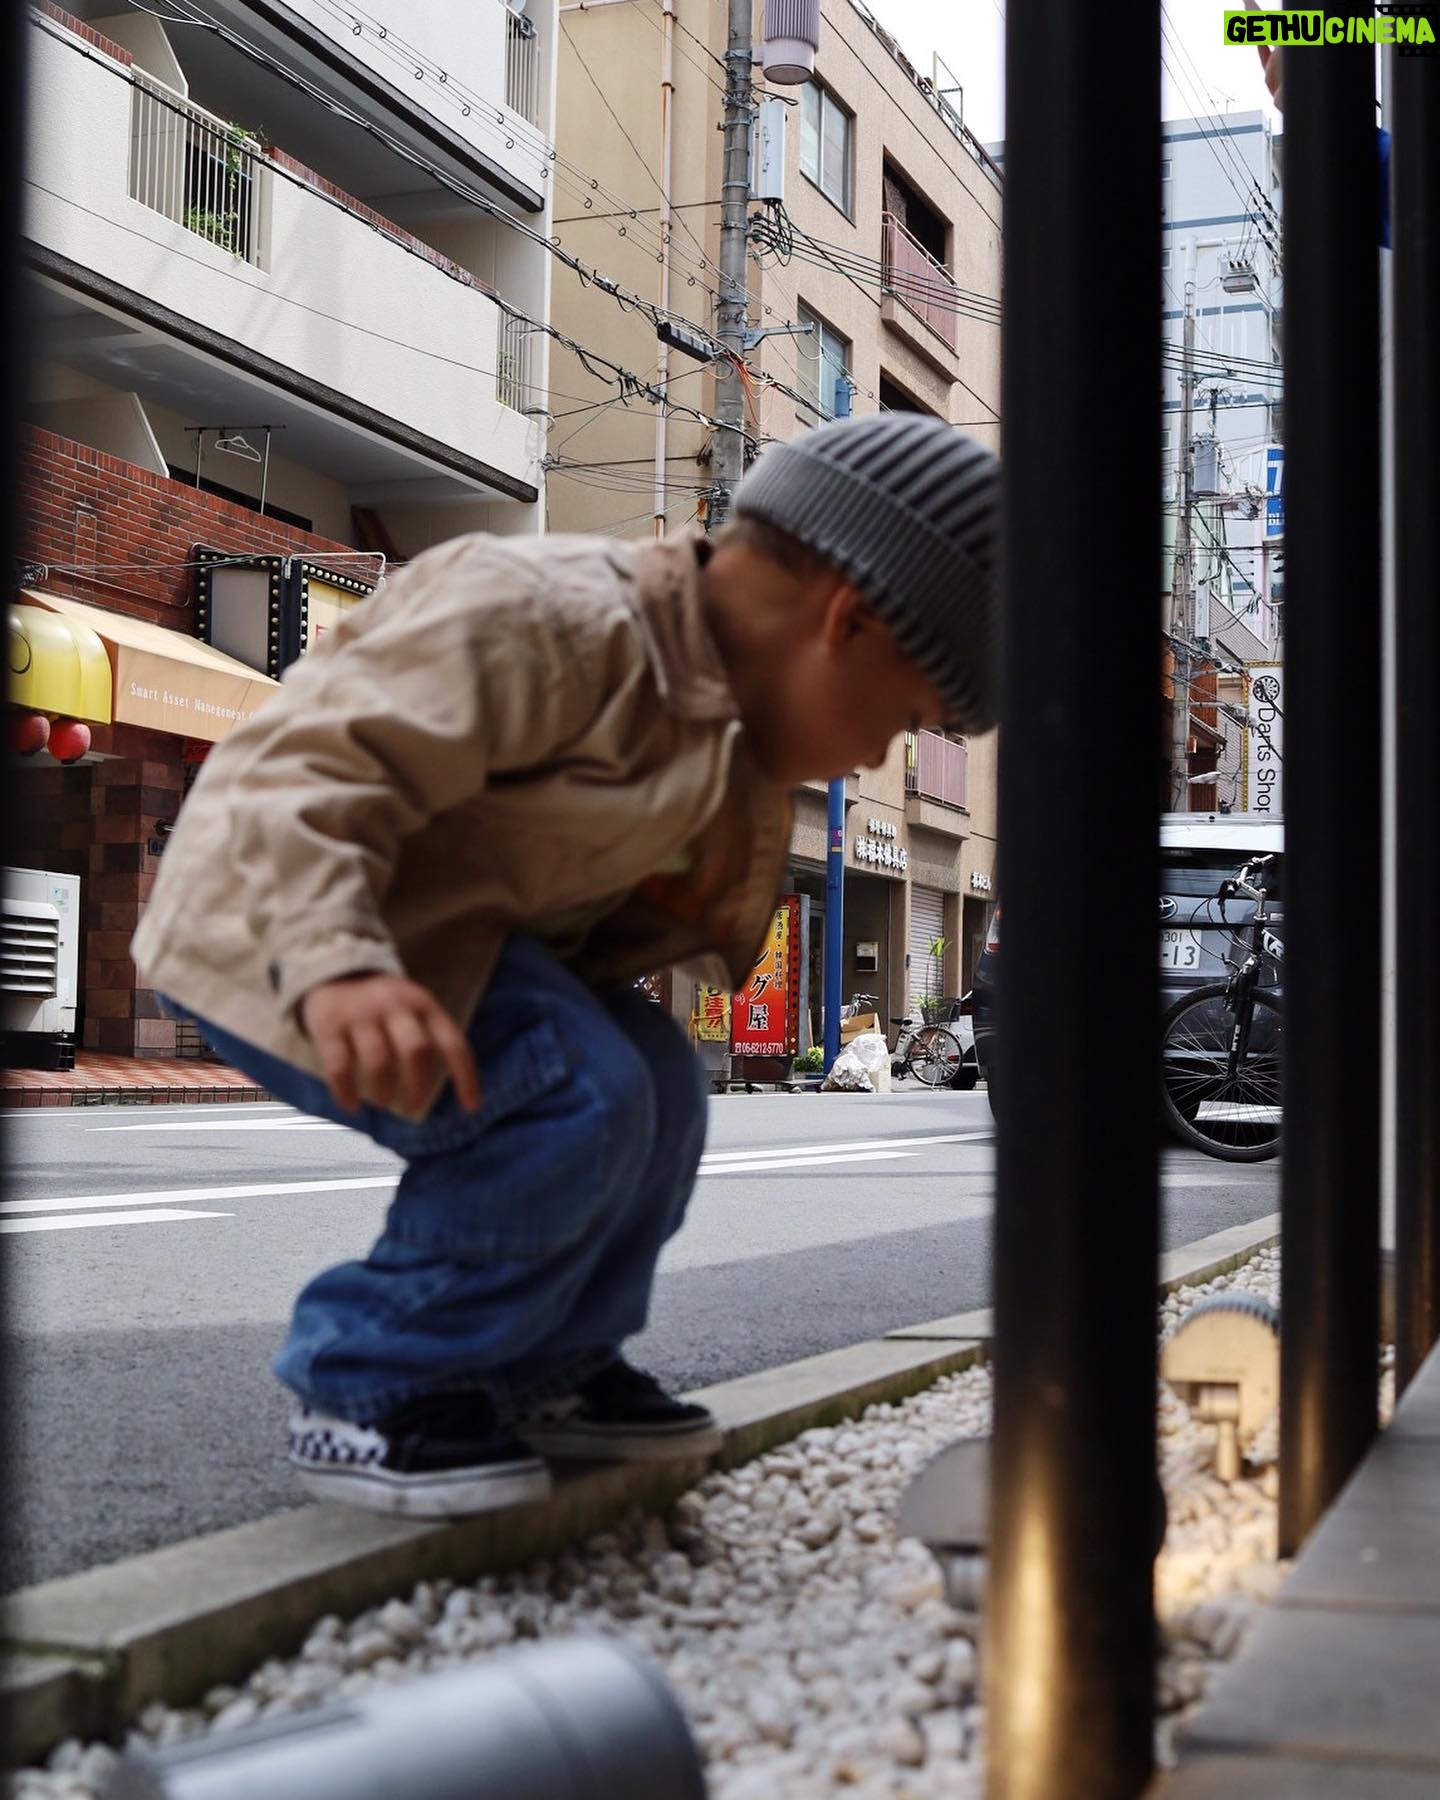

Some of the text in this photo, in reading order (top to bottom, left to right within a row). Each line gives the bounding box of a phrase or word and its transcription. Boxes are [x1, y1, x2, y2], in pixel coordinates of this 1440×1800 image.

[130, 682, 159, 701] Smart
[162, 690, 190, 709] Asset
[1257, 706, 1277, 763] Darts
[742, 1042, 784, 1055] 06-6212-5770
